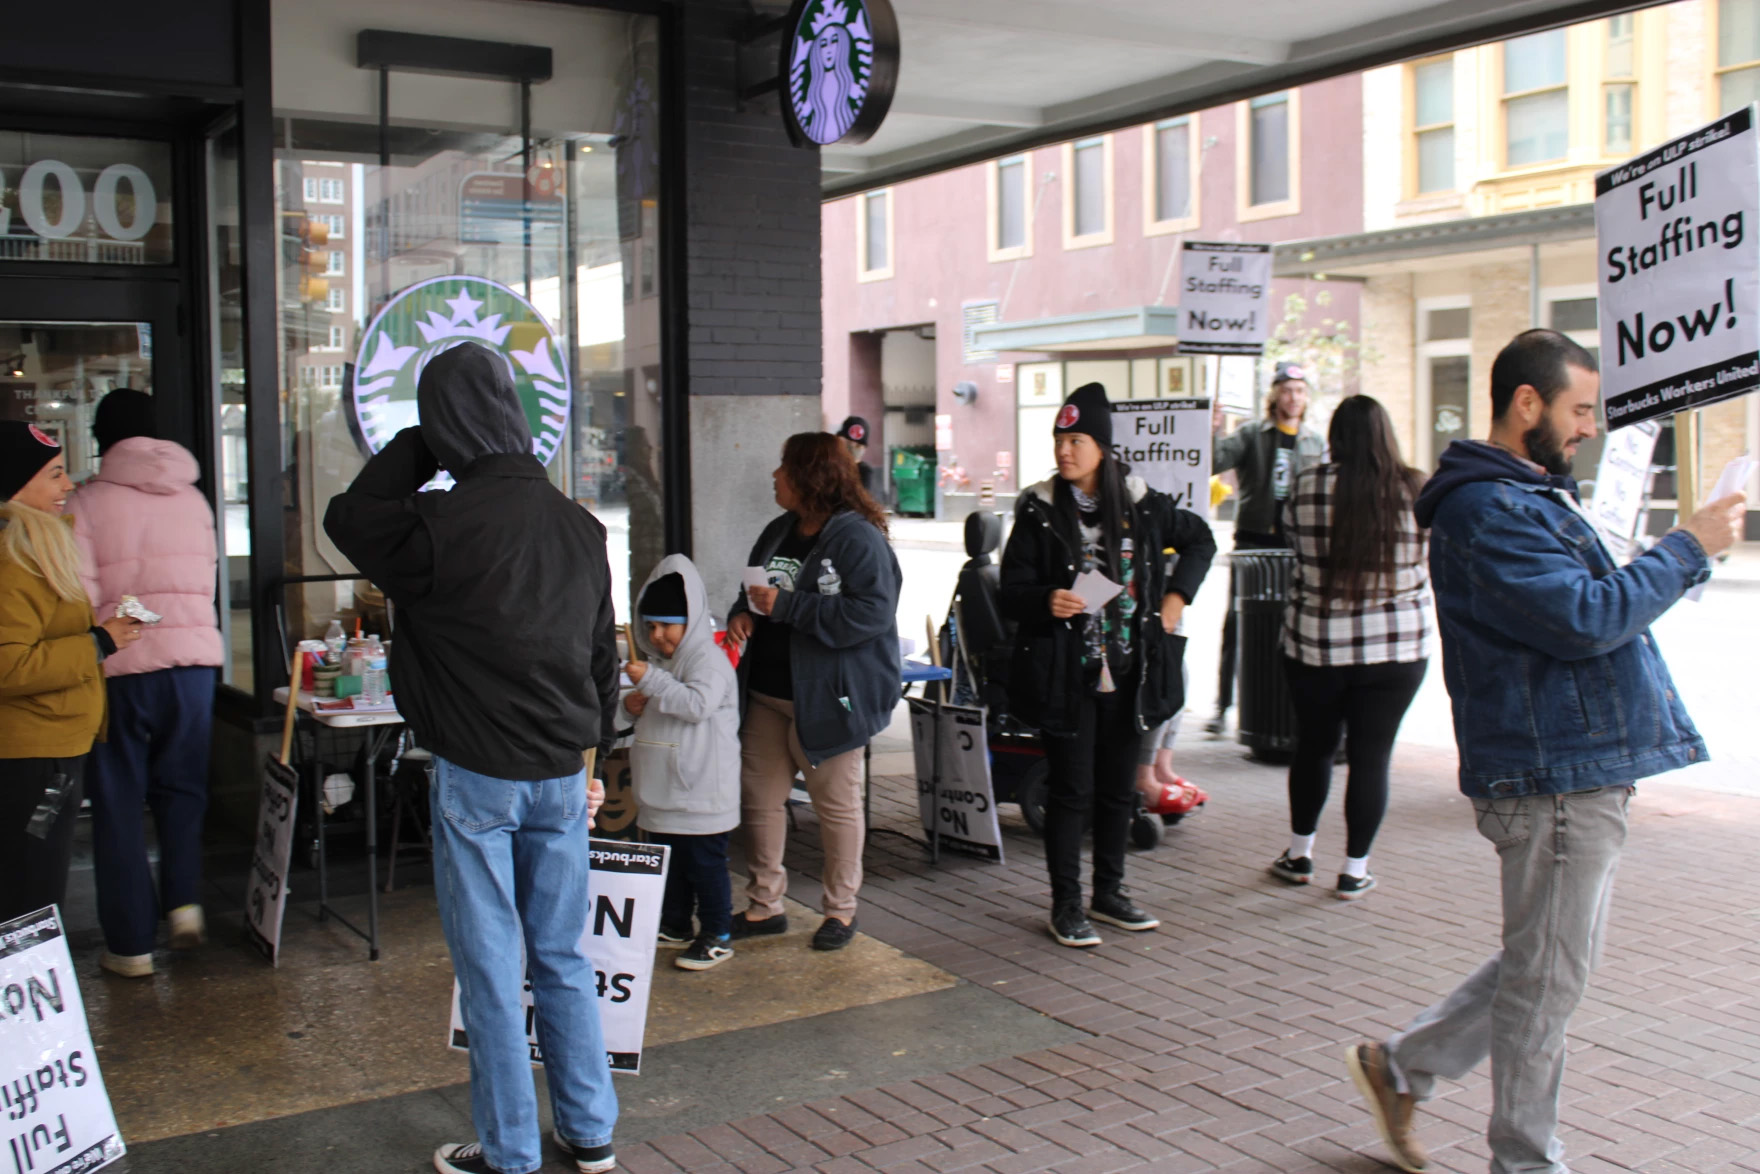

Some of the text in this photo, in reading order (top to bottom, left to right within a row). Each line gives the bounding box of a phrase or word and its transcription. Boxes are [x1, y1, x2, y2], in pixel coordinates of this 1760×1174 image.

[1610, 163, 1647, 186] We're
[1662, 140, 1688, 162] ULP
[0, 159, 157, 241] 00
[1639, 160, 1697, 221] Full
[1208, 255, 1243, 272] Full
[1607, 210, 1744, 284] Staffing
[1185, 276, 1262, 299] Staffing
[1187, 310, 1256, 331] Now!
[1617, 277, 1737, 367] Now!
[1607, 359, 1759, 419] Starbucks Workers United
[1135, 415, 1175, 435] Full
[1111, 442, 1201, 467] Staffing
[940, 807, 969, 836] No
[589, 850, 661, 867] Starbucks
[0, 967, 66, 1022] No
[0, 1050, 88, 1121] Staffi
[9, 1113, 73, 1174] Full
